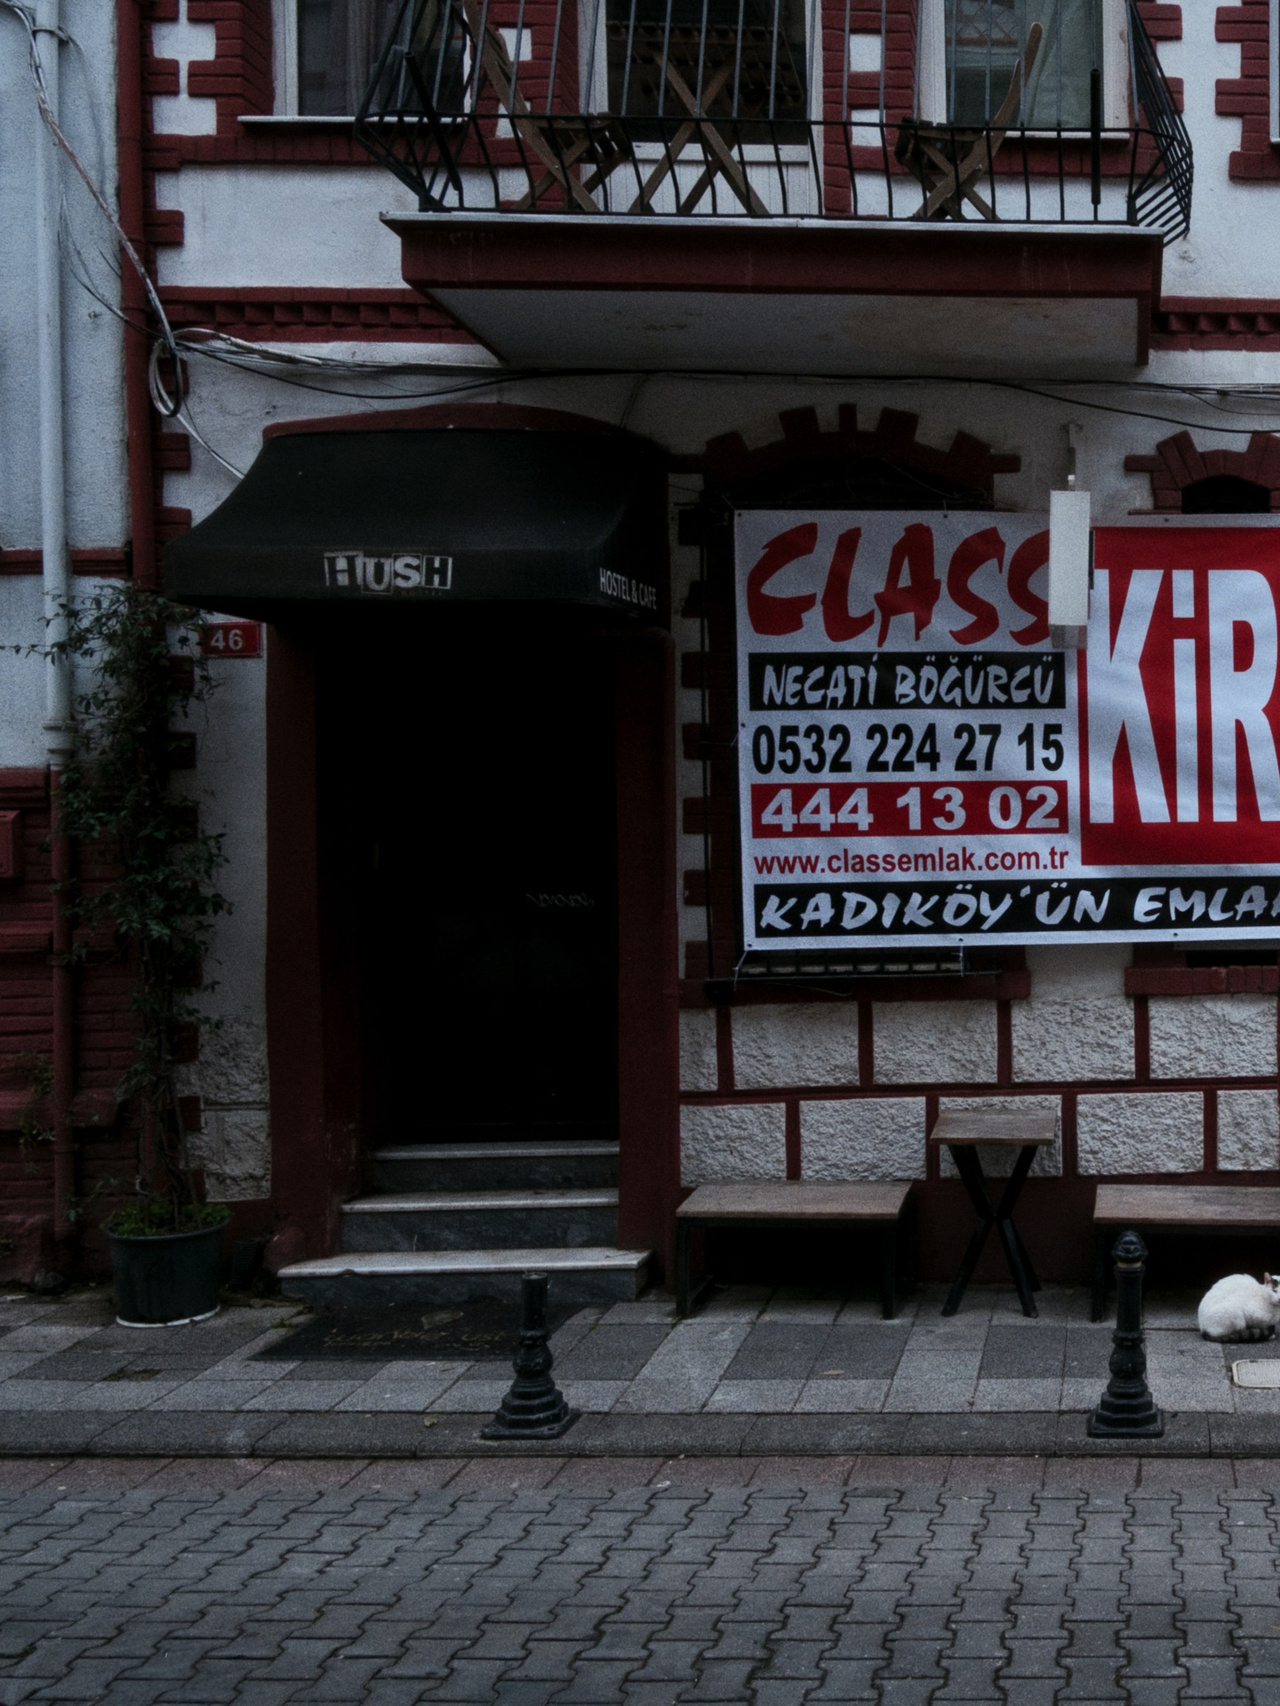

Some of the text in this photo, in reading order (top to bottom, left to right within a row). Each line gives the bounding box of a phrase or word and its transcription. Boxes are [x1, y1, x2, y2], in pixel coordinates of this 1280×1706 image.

[324, 551, 453, 594] HUSH
[600, 567, 657, 611] HOSTEL & CAFE
[747, 522, 1051, 648] CLASS
[210, 628, 243, 651] 46
[763, 654, 1055, 708] NECATİ BÖĞÜRCÜ
[752, 723, 1064, 775] 0532 224 27 15
[761, 786, 1060, 832] 444 13 02
[754, 847, 1069, 874] www.classemlak.com.tr
